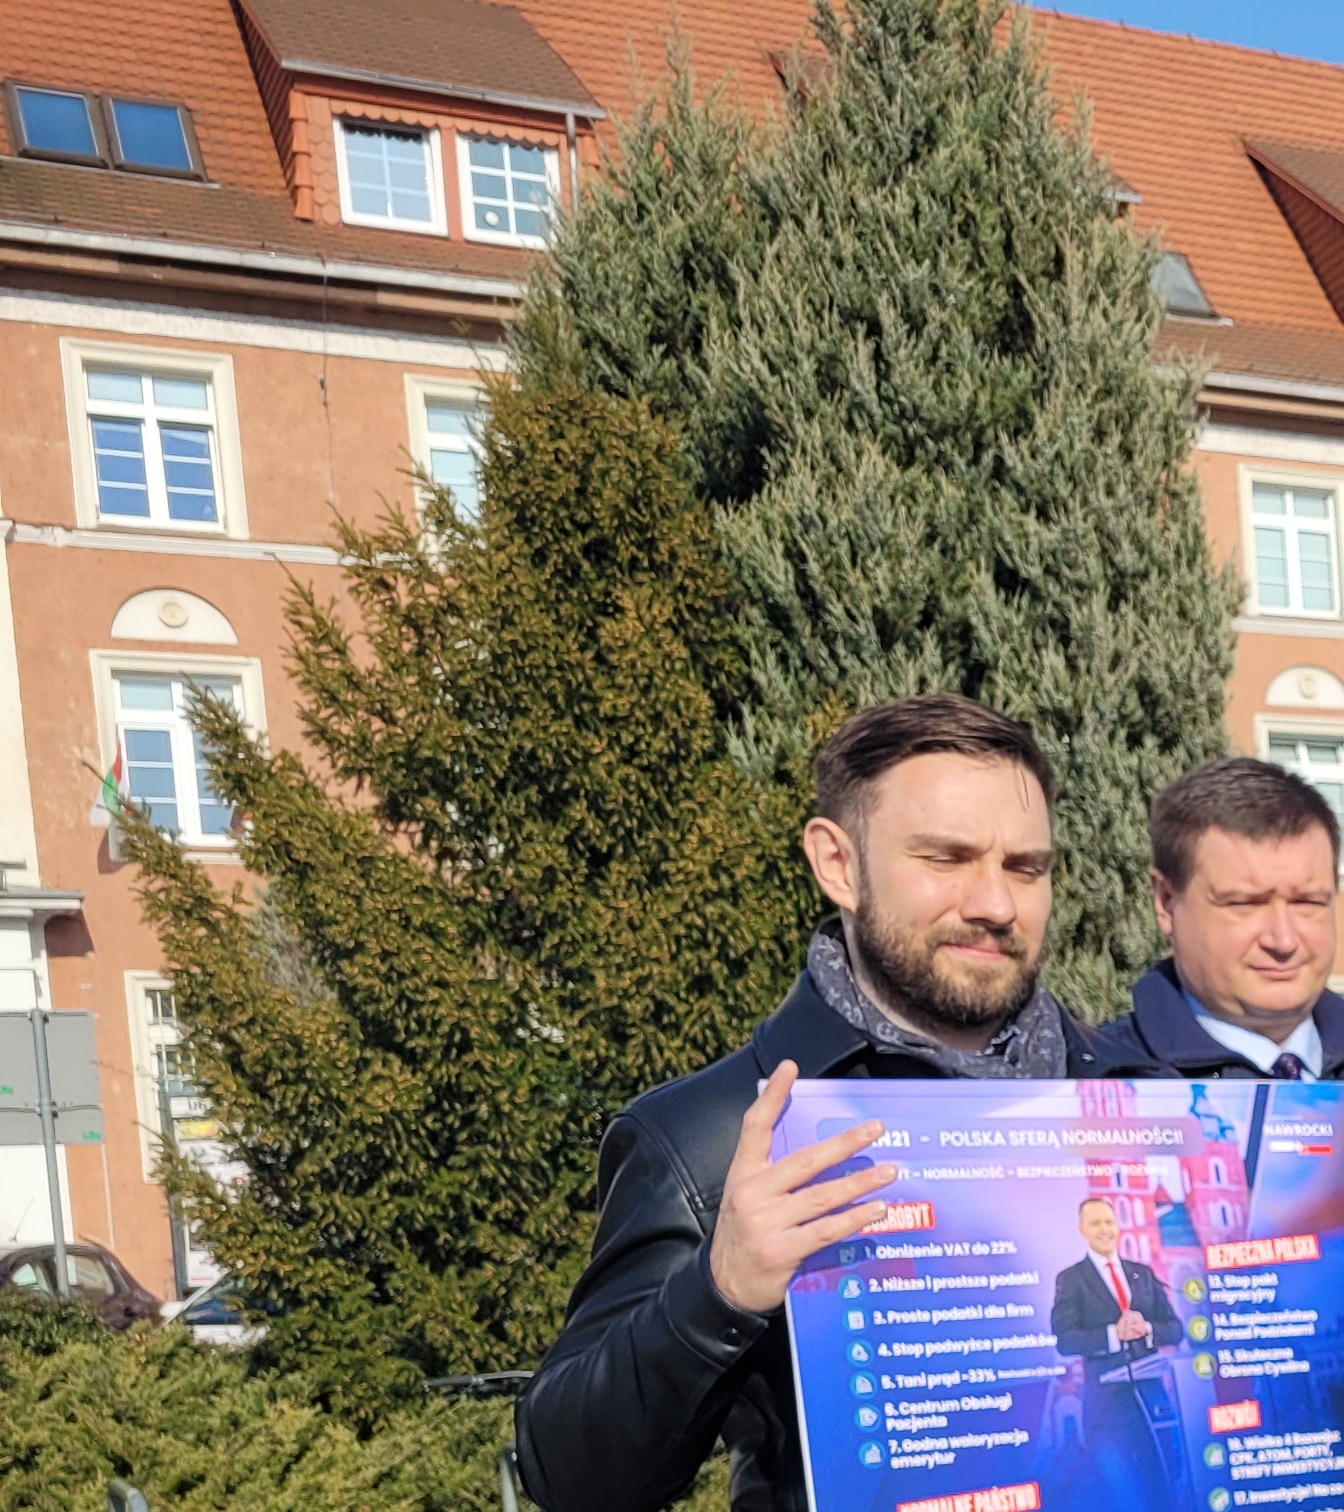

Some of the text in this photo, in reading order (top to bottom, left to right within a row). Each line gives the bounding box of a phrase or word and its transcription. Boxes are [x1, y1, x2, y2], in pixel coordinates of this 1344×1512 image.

[940, 1129, 1005, 1148] POLSKA
[1009, 1128, 1060, 1149] SFERĄ
[1265, 1122, 1333, 1137] NAWROCKI
[876, 1242, 942, 1259] Obniżenie
[943, 1242, 971, 1257] VAT
[972, 1240, 989, 1256] do
[883, 1275, 925, 1292] Niższe
[933, 1273, 988, 1292] prostsze
[990, 1270, 1039, 1290] podatki
[887, 1308, 930, 1324] Proste
[932, 1303, 983, 1325] podatki
[1006, 1302, 1035, 1318] firm
[892, 1342, 924, 1358] Stop
[993, 1333, 1058, 1353] podatków
[896, 1372, 926, 1388] Tani
[899, 1398, 960, 1415] Centrum
[886, 1415, 948, 1433] Pacjenta
[902, 1435, 949, 1453] Godna
[949, 1428, 1029, 1449] waloryzacja
[890, 1451, 957, 1470] emerytur
